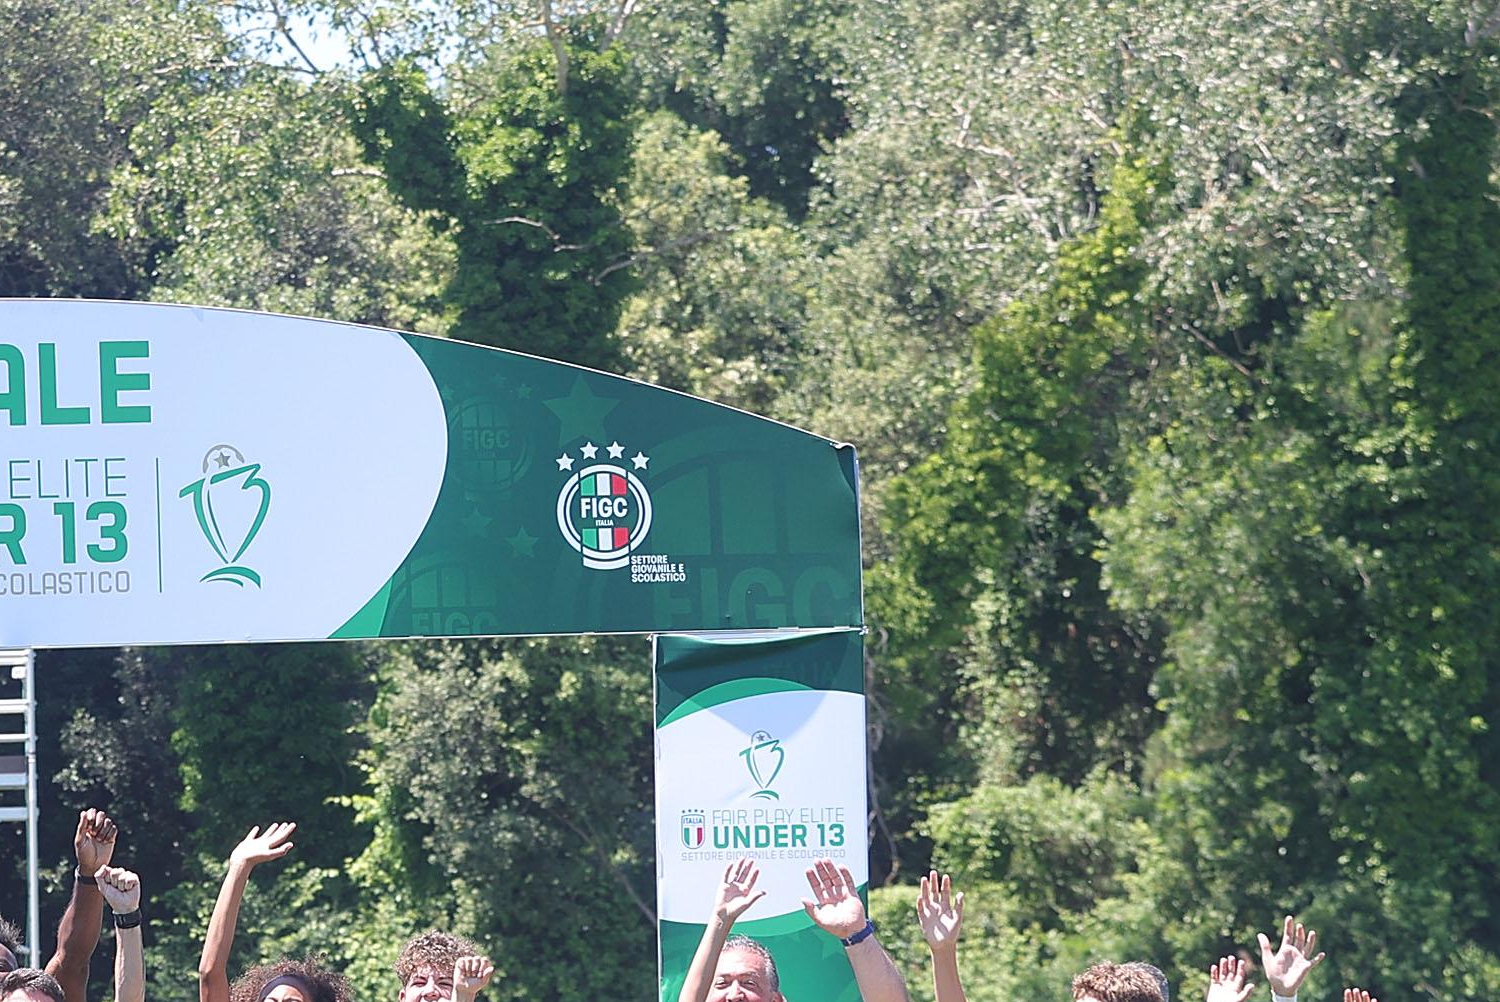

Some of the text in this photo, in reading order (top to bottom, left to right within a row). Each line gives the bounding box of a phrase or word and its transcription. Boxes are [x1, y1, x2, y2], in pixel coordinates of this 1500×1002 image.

[8, 457, 128, 499] ELITE
[580, 498, 629, 519] FIGC
[53, 501, 129, 564] 13
[631, 555, 668, 565] SETTORE
[631, 563, 685, 574] GIOVANILE E
[631, 572, 686, 583] SCOLASTICO
[683, 817, 703, 825] ITALIA
[712, 807, 845, 824] FAIR PLAY ELITE
[713, 823, 845, 849] UNDER 13
[681, 849, 846, 862] SETTORE GIOVANILE E SCOLASTICO
